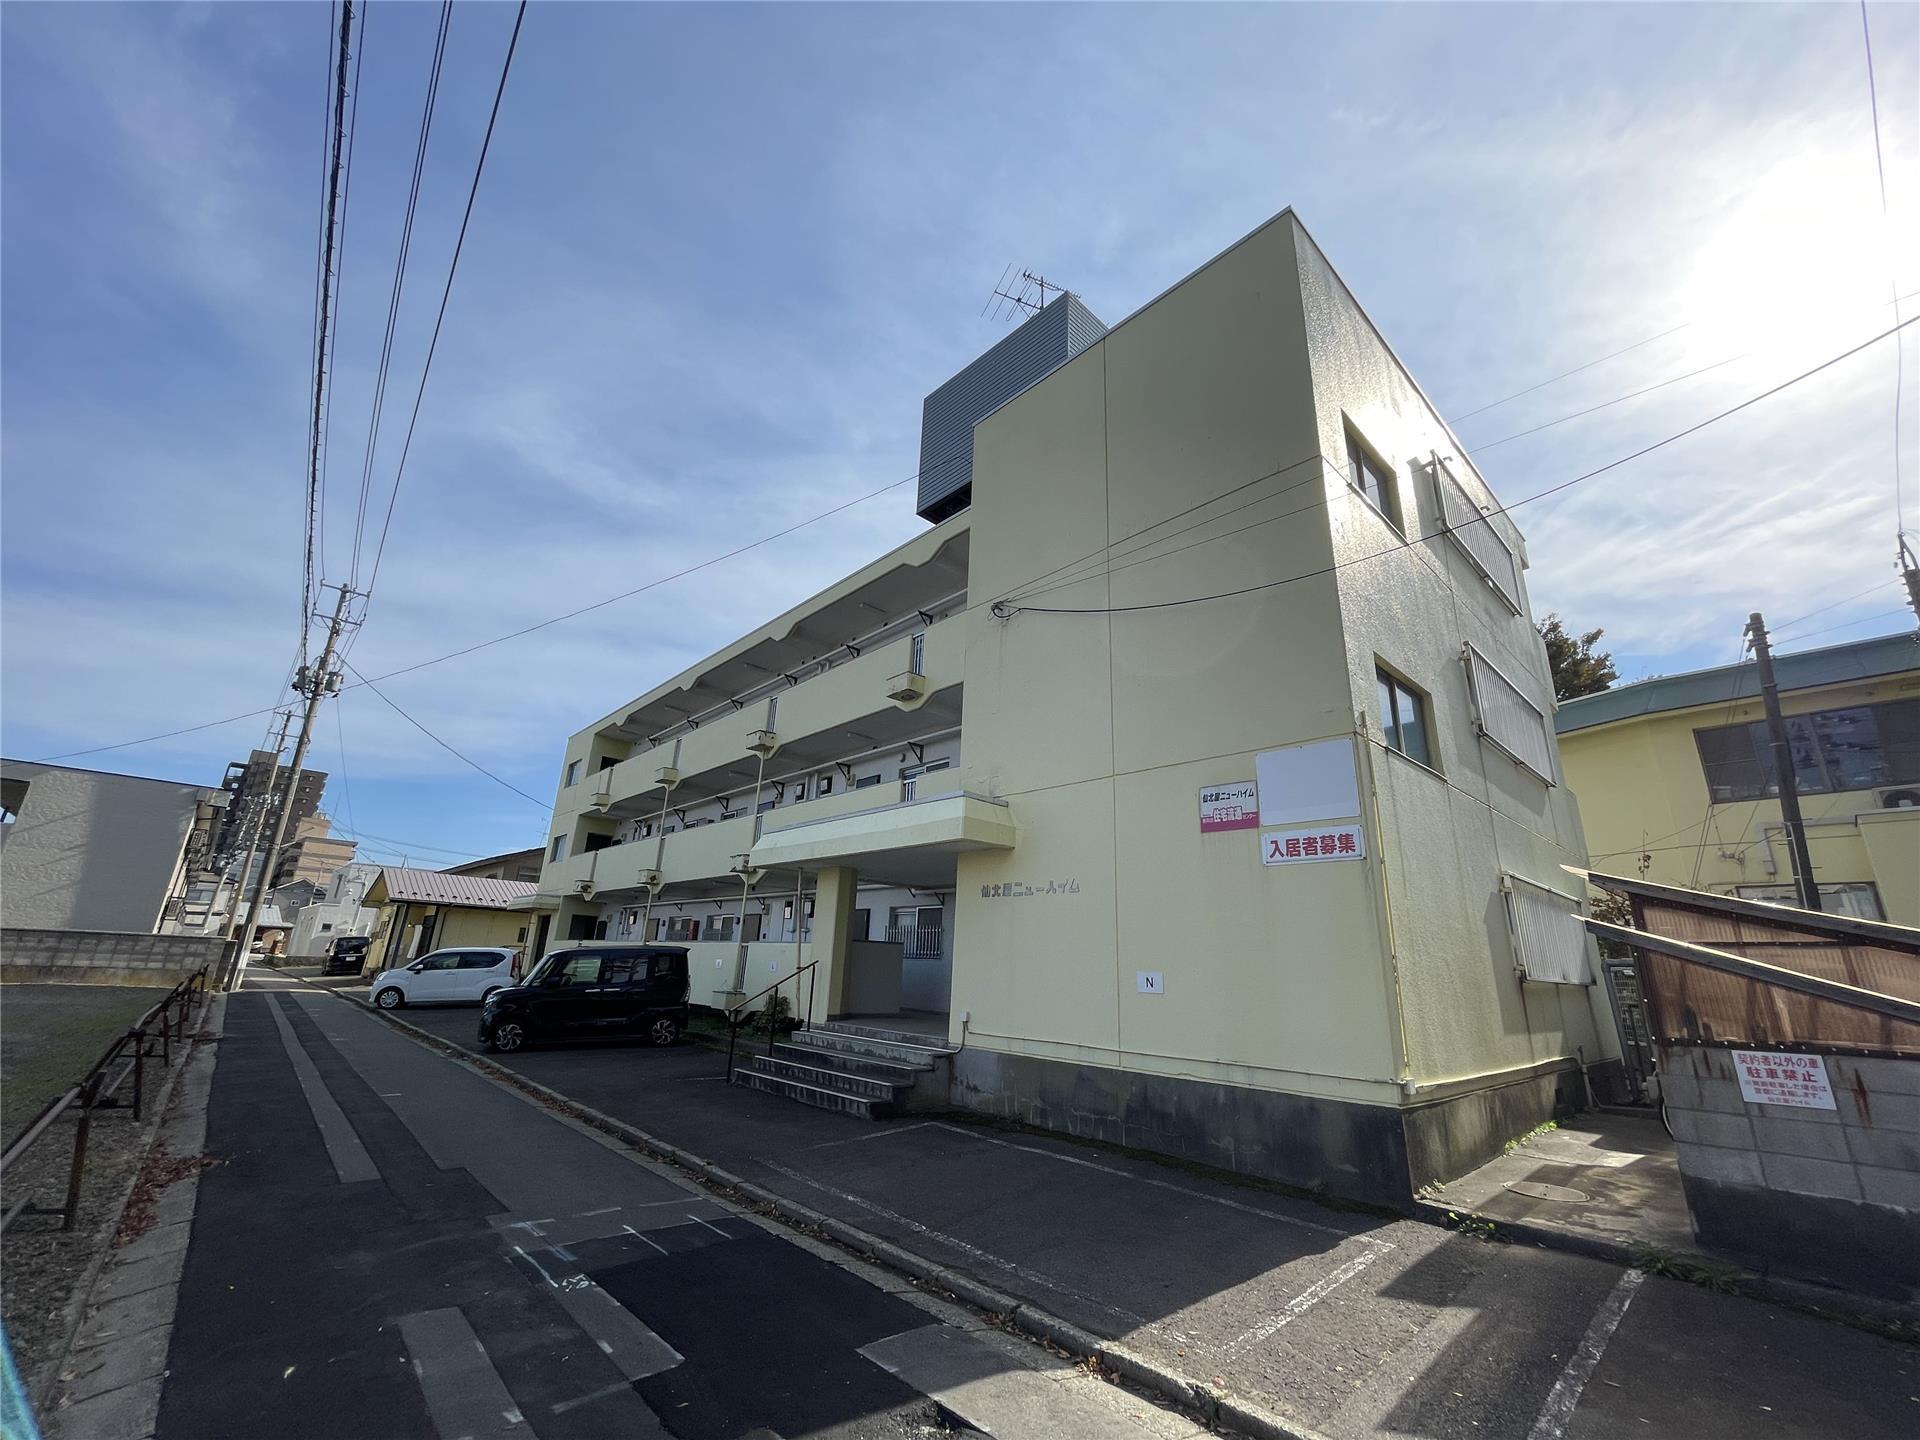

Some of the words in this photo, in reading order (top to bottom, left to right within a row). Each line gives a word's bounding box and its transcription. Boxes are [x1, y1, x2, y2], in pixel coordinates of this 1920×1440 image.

[1269, 833, 1356, 859] 入居者募集
[1146, 977, 1154, 988] N
[1737, 1053, 1820, 1068] 契約者以外の車
[1746, 1066, 1818, 1083] 駐車禁止
